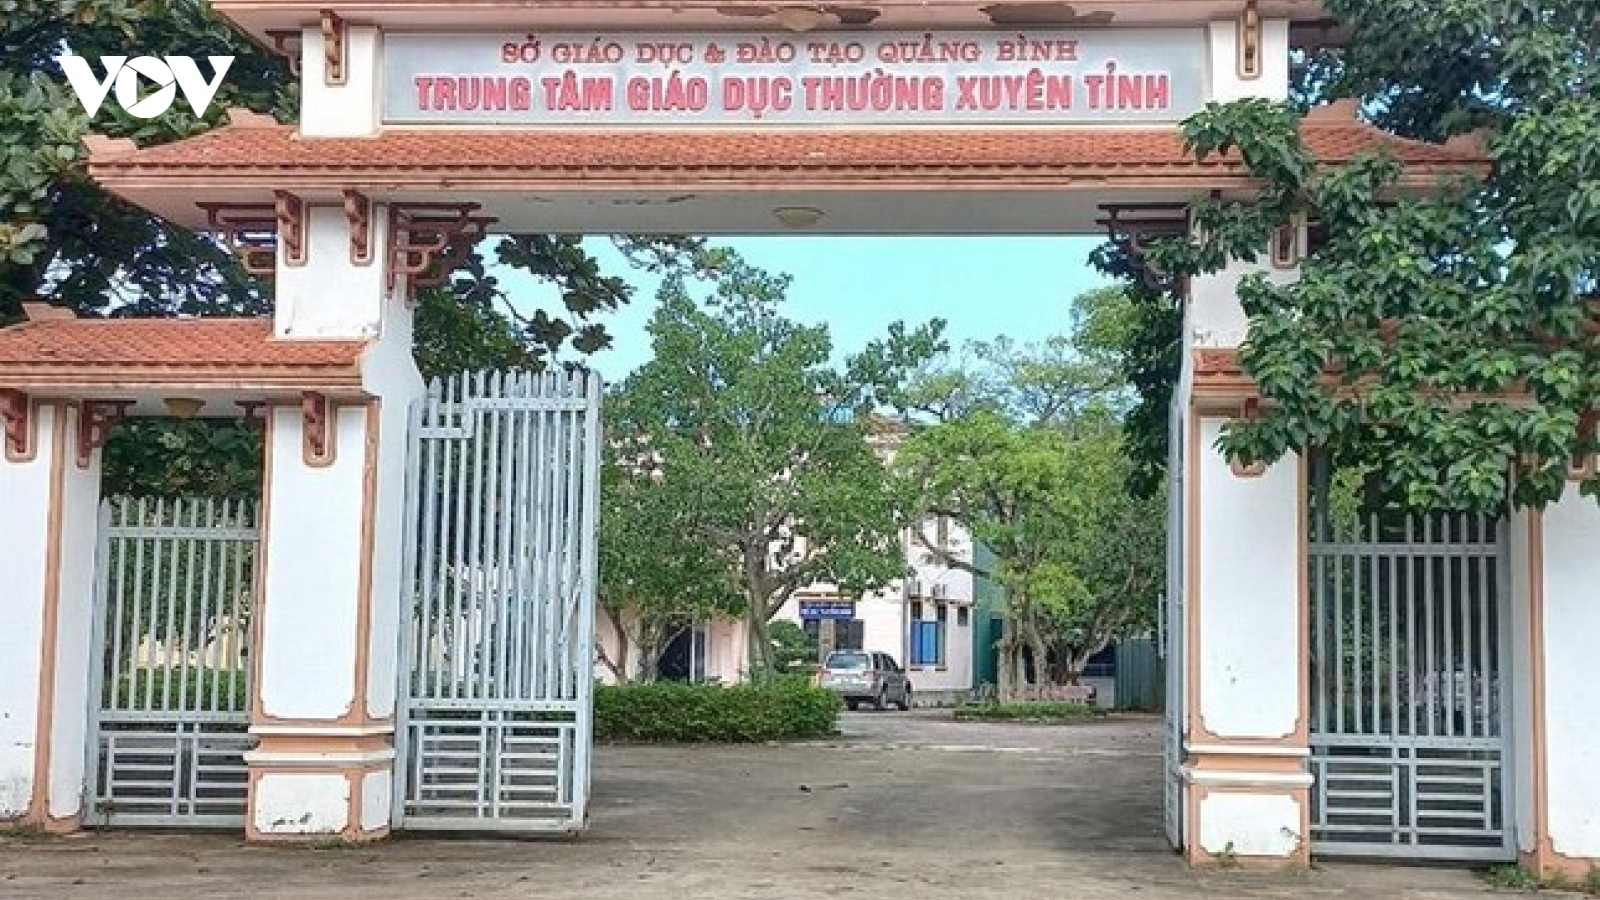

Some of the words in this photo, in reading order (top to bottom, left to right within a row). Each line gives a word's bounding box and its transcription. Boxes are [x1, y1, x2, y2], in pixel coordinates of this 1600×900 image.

[501, 35, 541, 63] SỞ
[551, 38, 624, 63] GIÁO
[635, 43, 694, 68] DỤC
[703, 43, 726, 62] &
[736, 37, 797, 63] ĐÀO
[806, 41, 866, 67] TẠO
[877, 34, 982, 63] QUẢNG
[996, 34, 1078, 61] BÌNH
[414, 76, 532, 111] TRUNG
[541, 71, 613, 111] TÂM
[626, 70, 709, 111] GIÁO
[722, 77, 793, 118] DỤC
[801, 68, 945, 111] THƯỜNG
[955, 68, 1073, 110] XUYÊN
[1084, 62, 1171, 110] TỈNH
